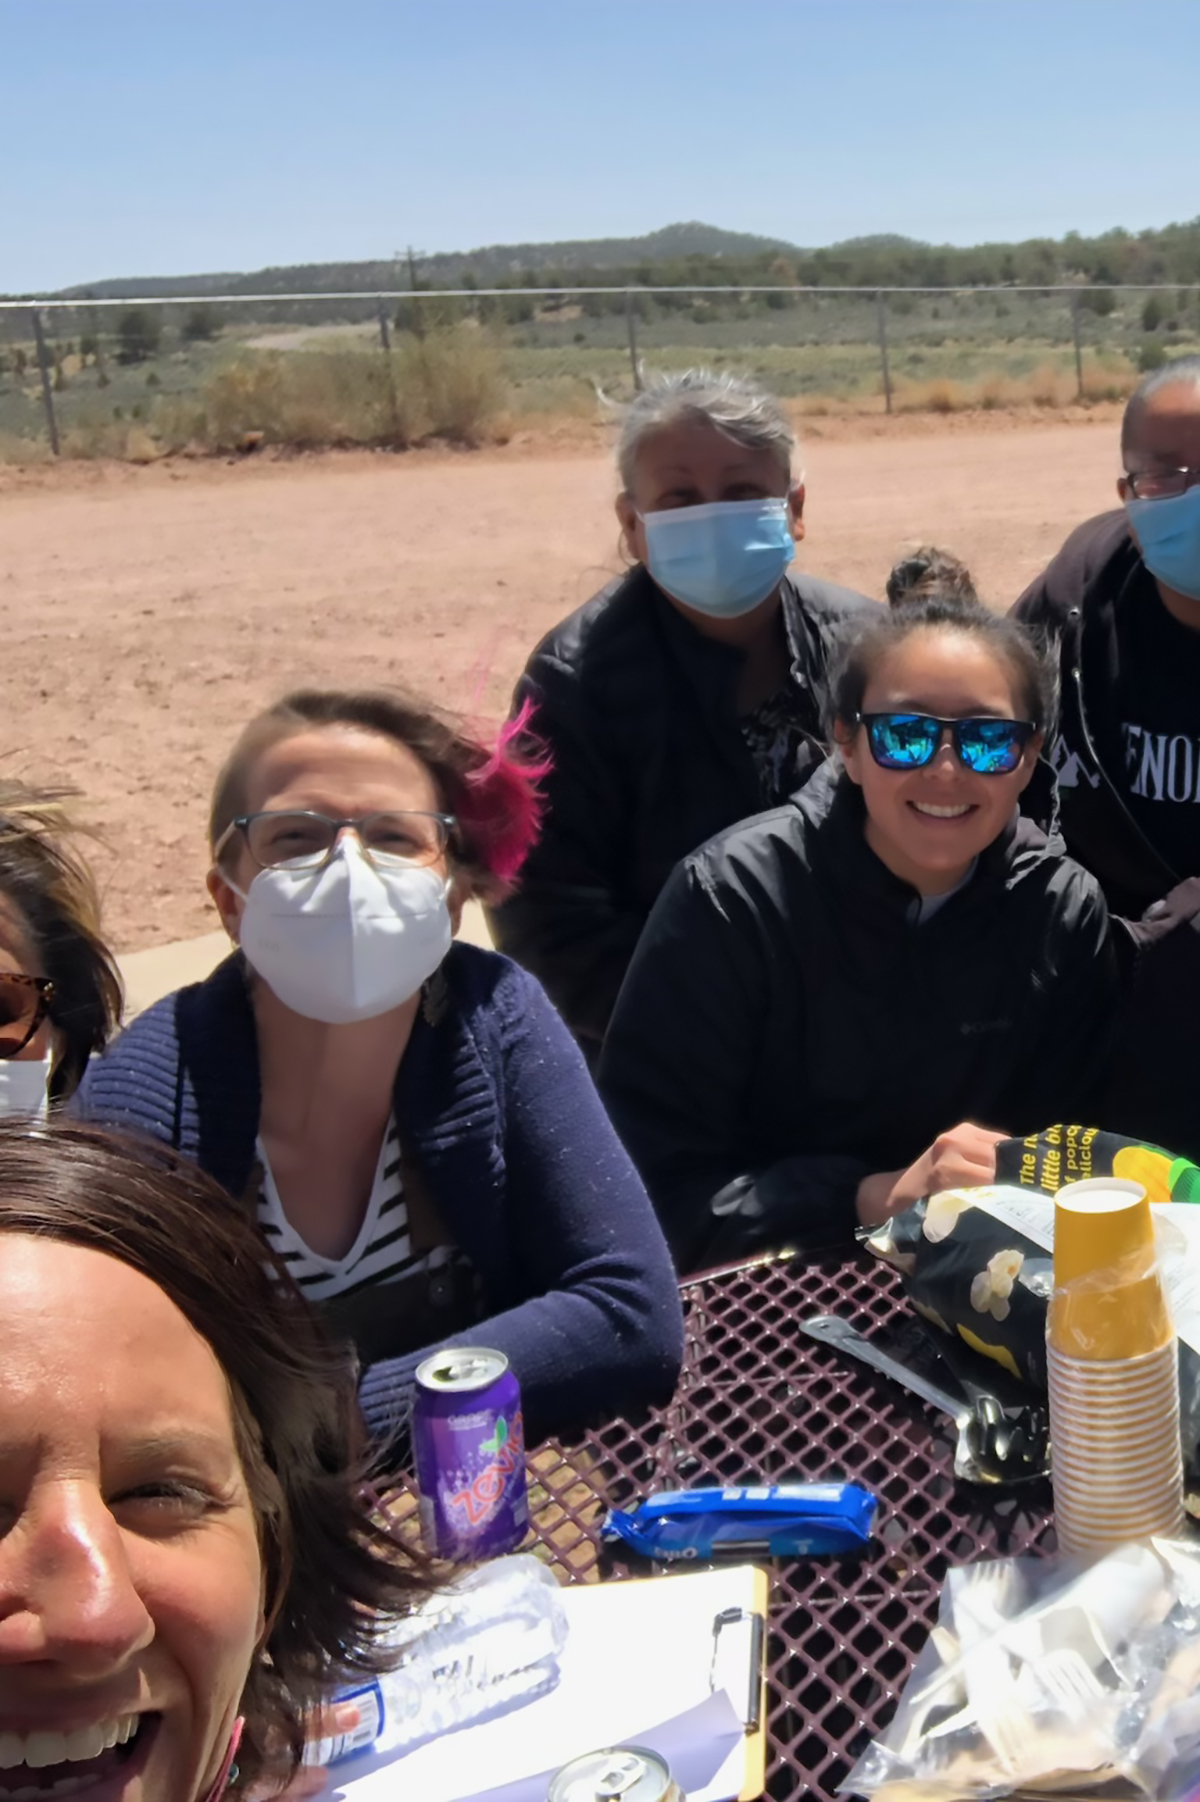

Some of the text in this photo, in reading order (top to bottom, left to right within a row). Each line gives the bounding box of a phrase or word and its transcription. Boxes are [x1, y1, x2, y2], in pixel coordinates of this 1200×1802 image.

[1019, 1153, 1036, 1185] The
[1041, 1149, 1061, 1191] little
[1079, 1127, 1100, 1180] eliciou
